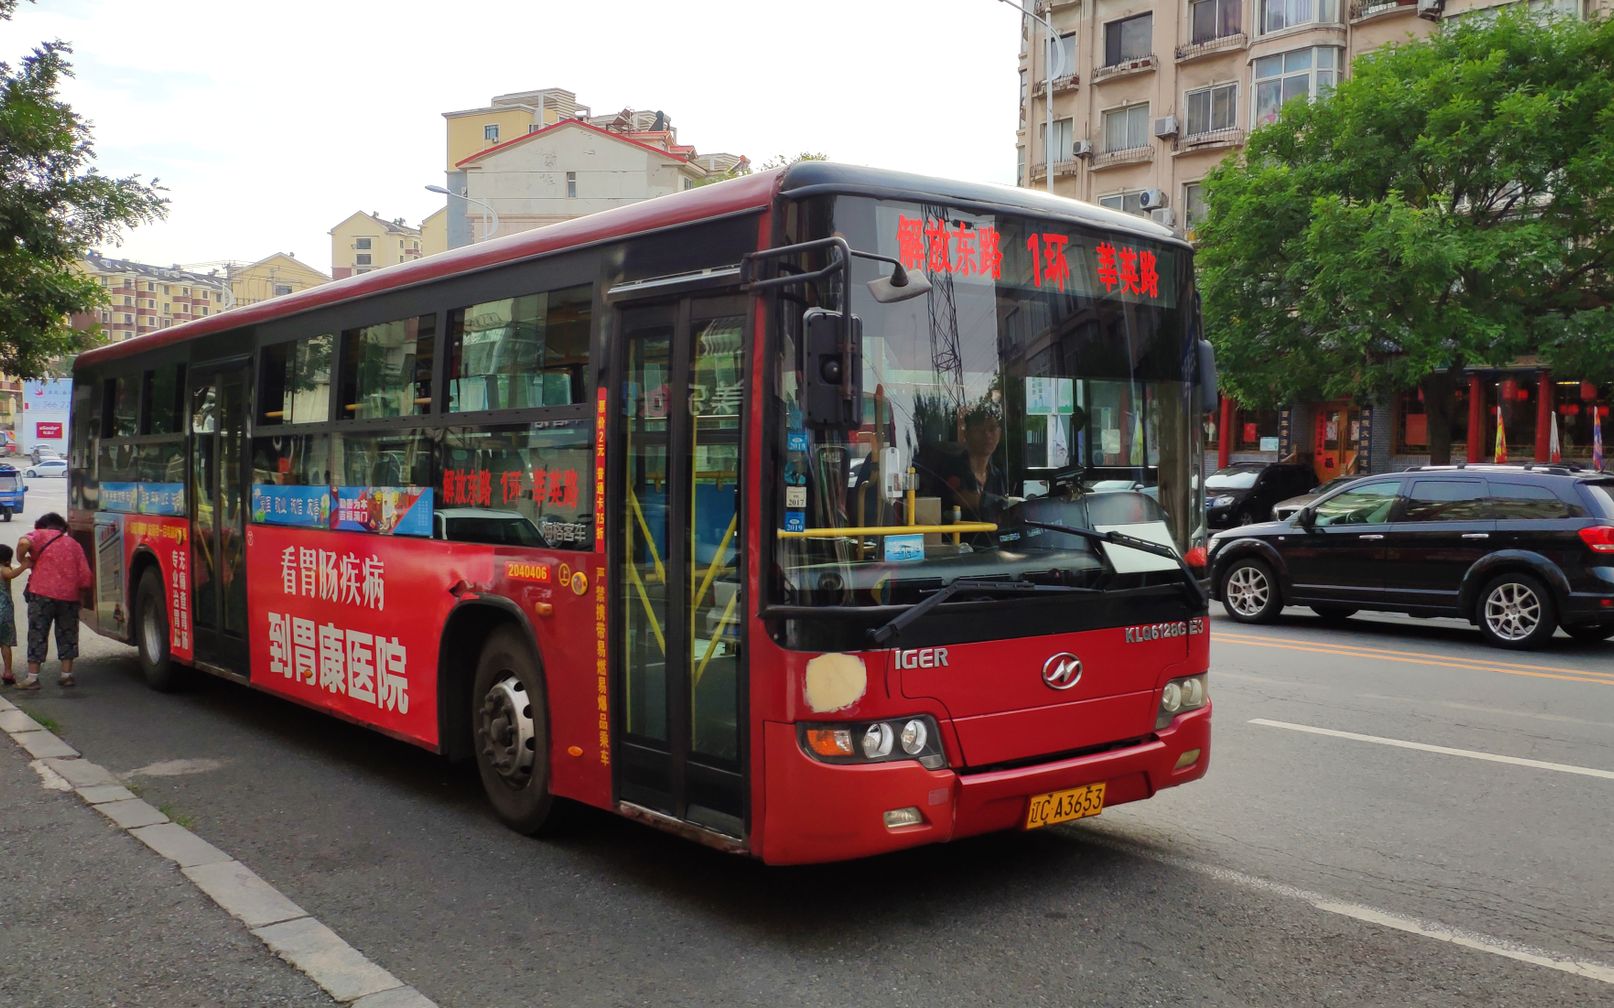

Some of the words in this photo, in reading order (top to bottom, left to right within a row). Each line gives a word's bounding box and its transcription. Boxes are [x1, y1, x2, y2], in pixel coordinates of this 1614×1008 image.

[896, 213, 1003, 280] 解放东路
[1027, 232, 1070, 293] 1环
[789, 442, 806, 450] 2018
[786, 524, 803, 532] 2019
[281, 546, 385, 611] 看胃肠疾病
[508, 563, 547, 579] 2040406
[268, 612, 409, 714] 到胃康医院
[895, 648, 949, 670] IGER
